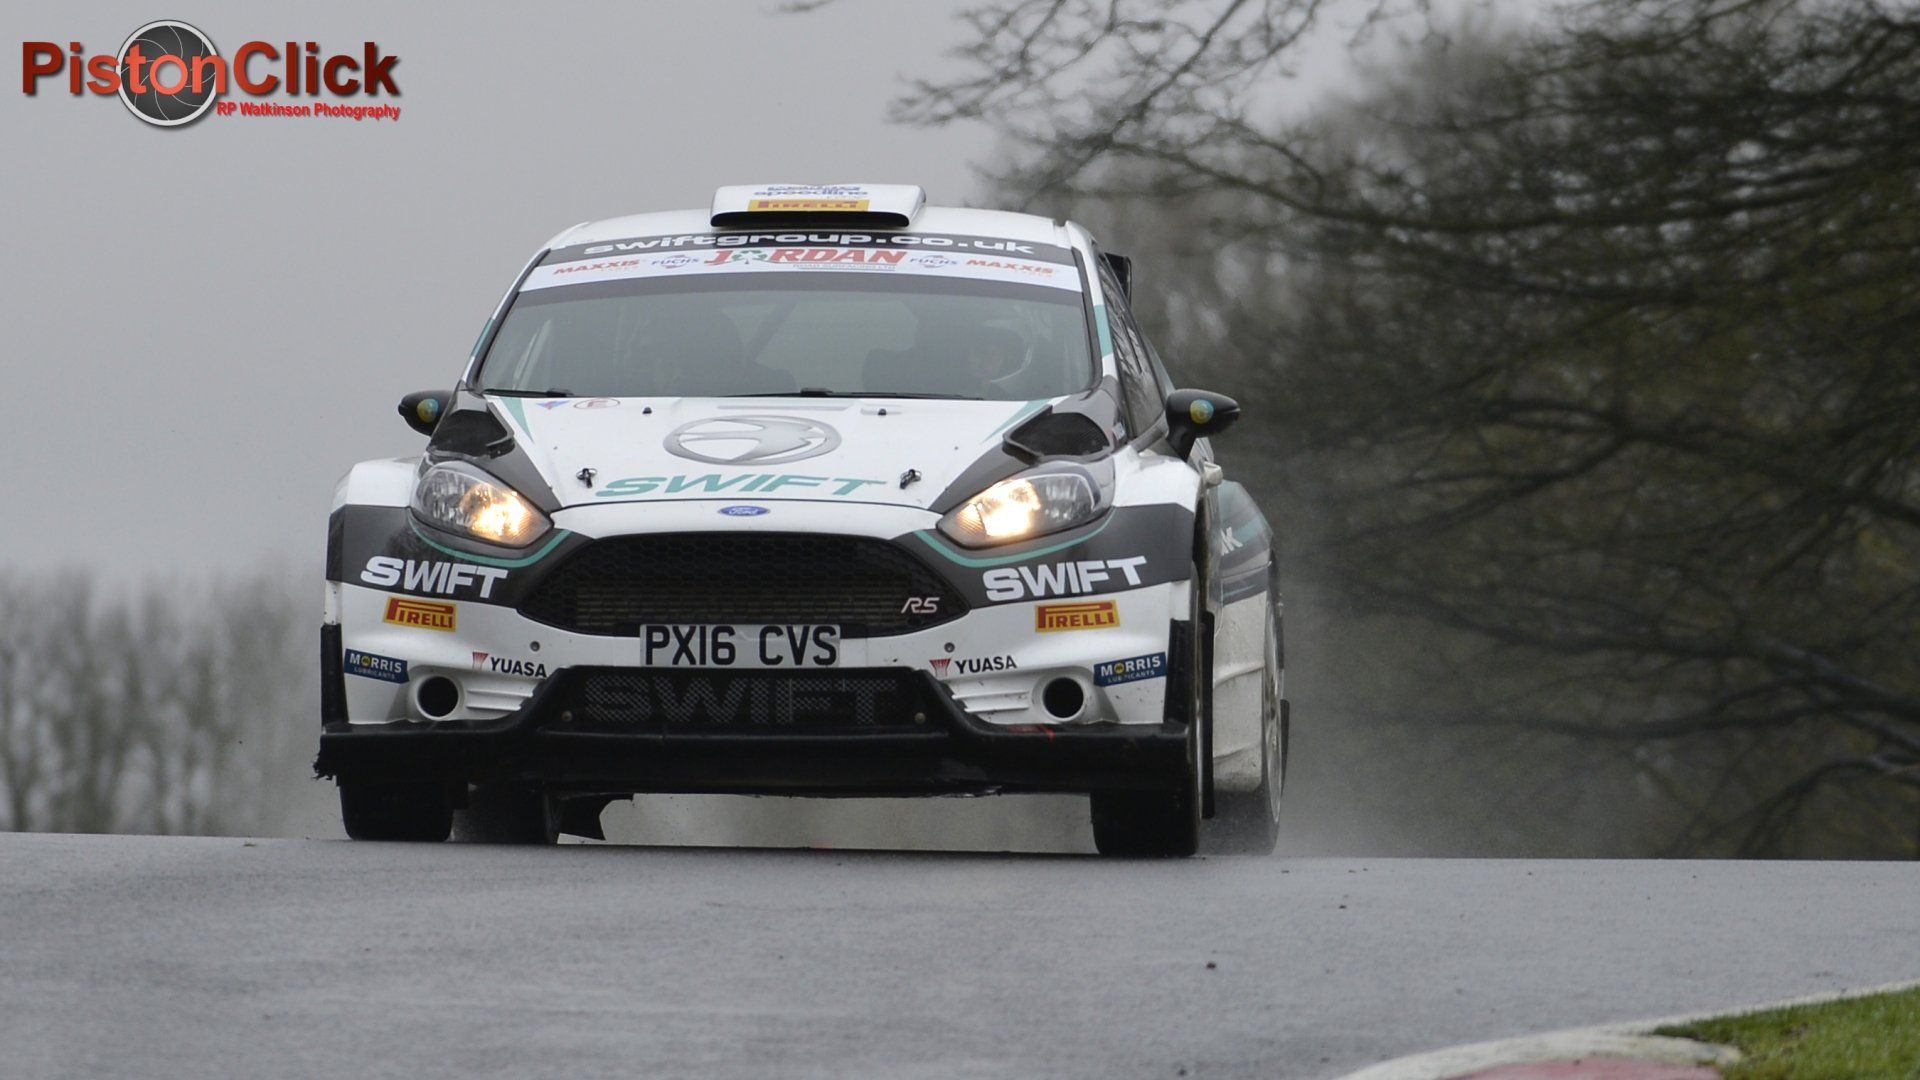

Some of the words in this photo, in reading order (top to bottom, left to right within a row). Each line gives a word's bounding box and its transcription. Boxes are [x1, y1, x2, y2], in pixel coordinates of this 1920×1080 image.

[584, 233, 1034, 255] swiftgroup.co.uk
[553, 259, 640, 275] MAXXIS
[651, 258, 700, 266] FUCHS
[909, 257, 958, 266] FUCHS
[966, 259, 1053, 274] MAXXIS
[595, 474, 886, 497] SWIFT
[360, 556, 508, 599] SWIFT
[982, 556, 1147, 601] SWIFT
[386, 599, 454, 629] PIRELLI
[901, 597, 940, 613] RS
[1038, 602, 1115, 629] PIRELLI
[645, 625, 736, 665] PX16
[759, 625, 837, 666] CVS
[350, 653, 402, 673] MORRIS
[490, 657, 547, 678] YUASA
[955, 656, 1017, 674] YUASA
[1101, 655, 1161, 677] MORRIS
[585, 676, 897, 723] SWIFT
